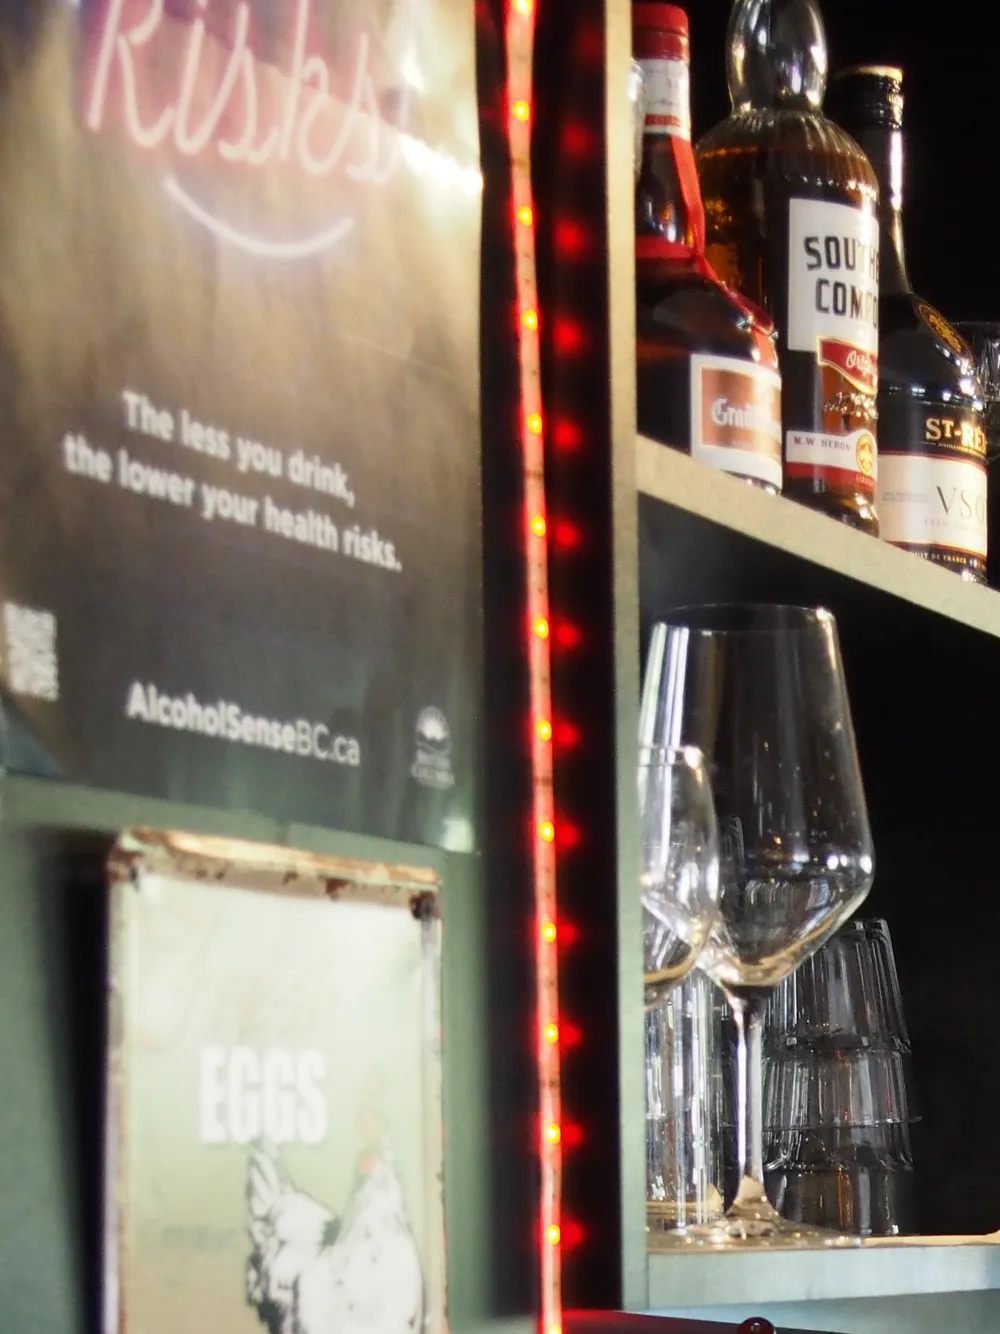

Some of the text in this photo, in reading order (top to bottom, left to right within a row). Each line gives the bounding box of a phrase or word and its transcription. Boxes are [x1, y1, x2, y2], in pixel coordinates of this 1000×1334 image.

[62, 434, 402, 571] the lower your health risks.
[122, 390, 355, 508] The less you drink,
[126, 680, 360, 767] AlcoholSenseBC.ca
[200, 1044, 328, 1145] EGGS
